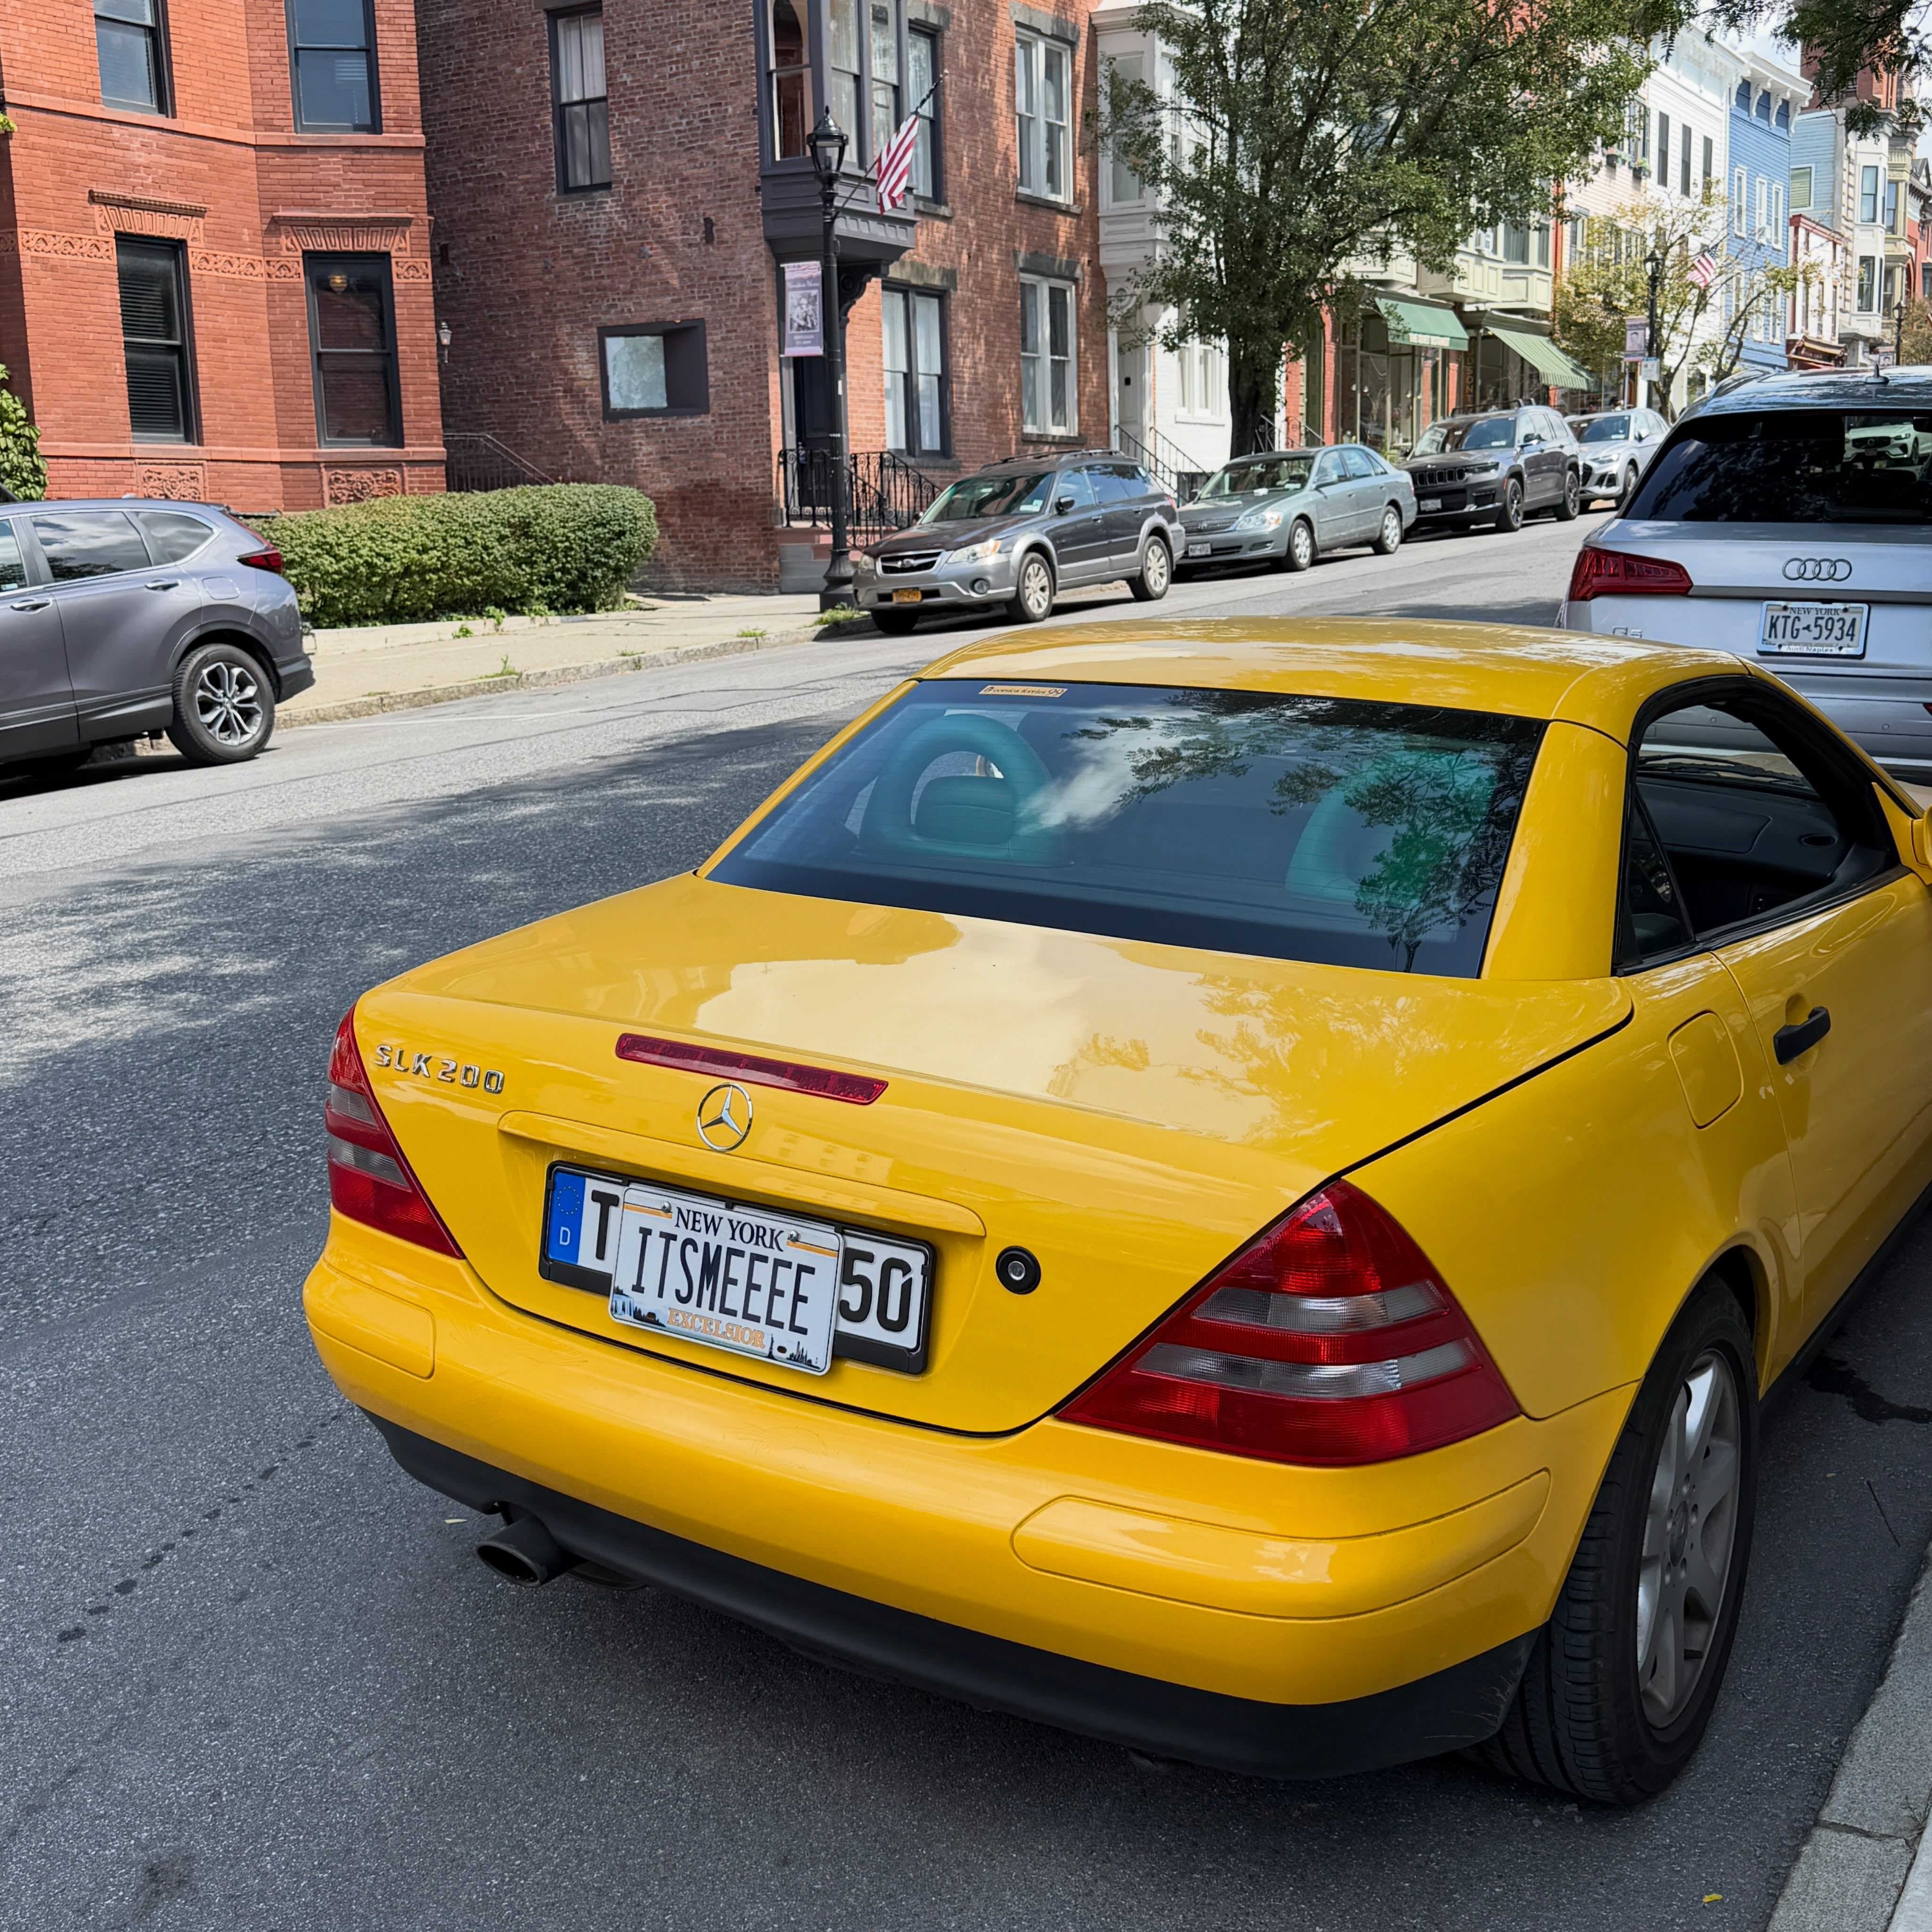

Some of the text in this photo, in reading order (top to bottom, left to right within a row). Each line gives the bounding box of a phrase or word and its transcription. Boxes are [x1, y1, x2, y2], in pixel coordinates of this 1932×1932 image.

[1815, 608, 1840, 616] YORK
[559, 1226, 571, 1246] D
[675, 1207, 784, 1252] NEW YORK
[632, 1226, 816, 1336] ITSMEEEE
[839, 1247, 913, 1332] 50
[667, 1307, 766, 1349] EXCELSIOR
